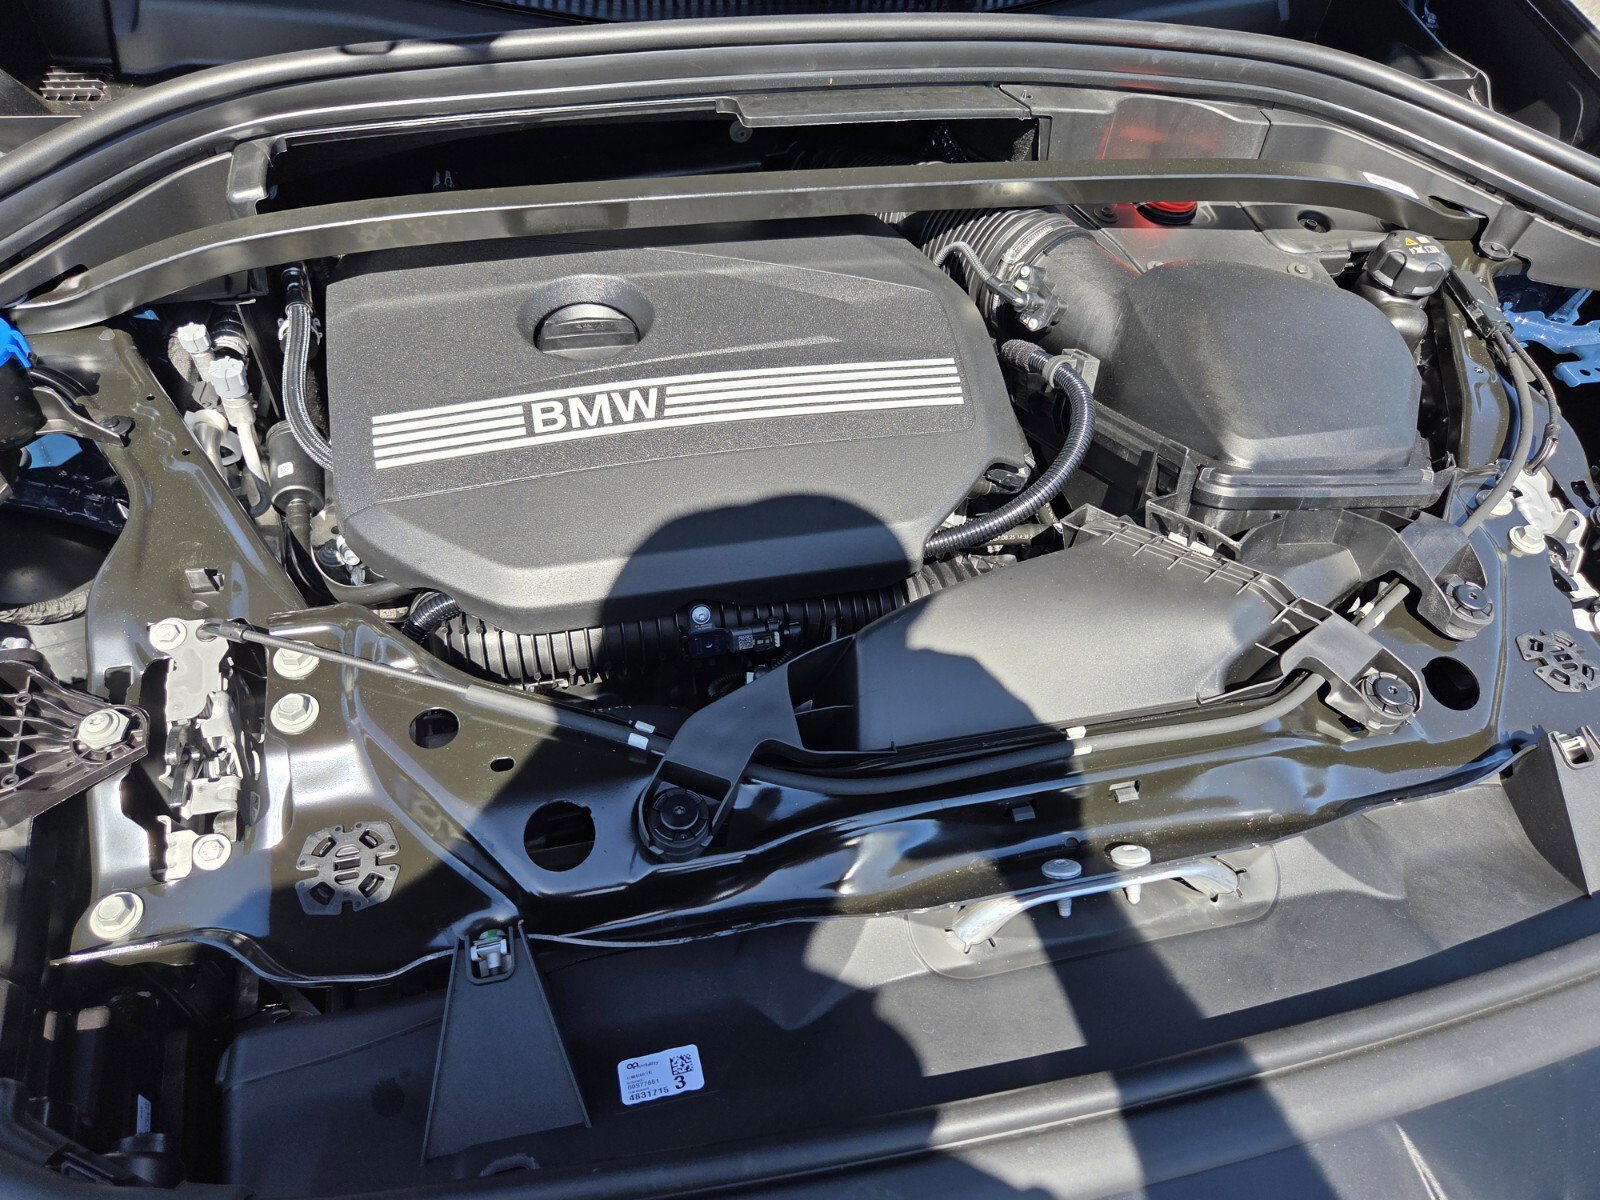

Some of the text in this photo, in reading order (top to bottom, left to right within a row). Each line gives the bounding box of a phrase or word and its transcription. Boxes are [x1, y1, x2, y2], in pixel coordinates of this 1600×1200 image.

[531, 387, 658, 433] BMW
[674, 1075, 687, 1090] 3
[629, 1086, 670, 1101] 4831715
